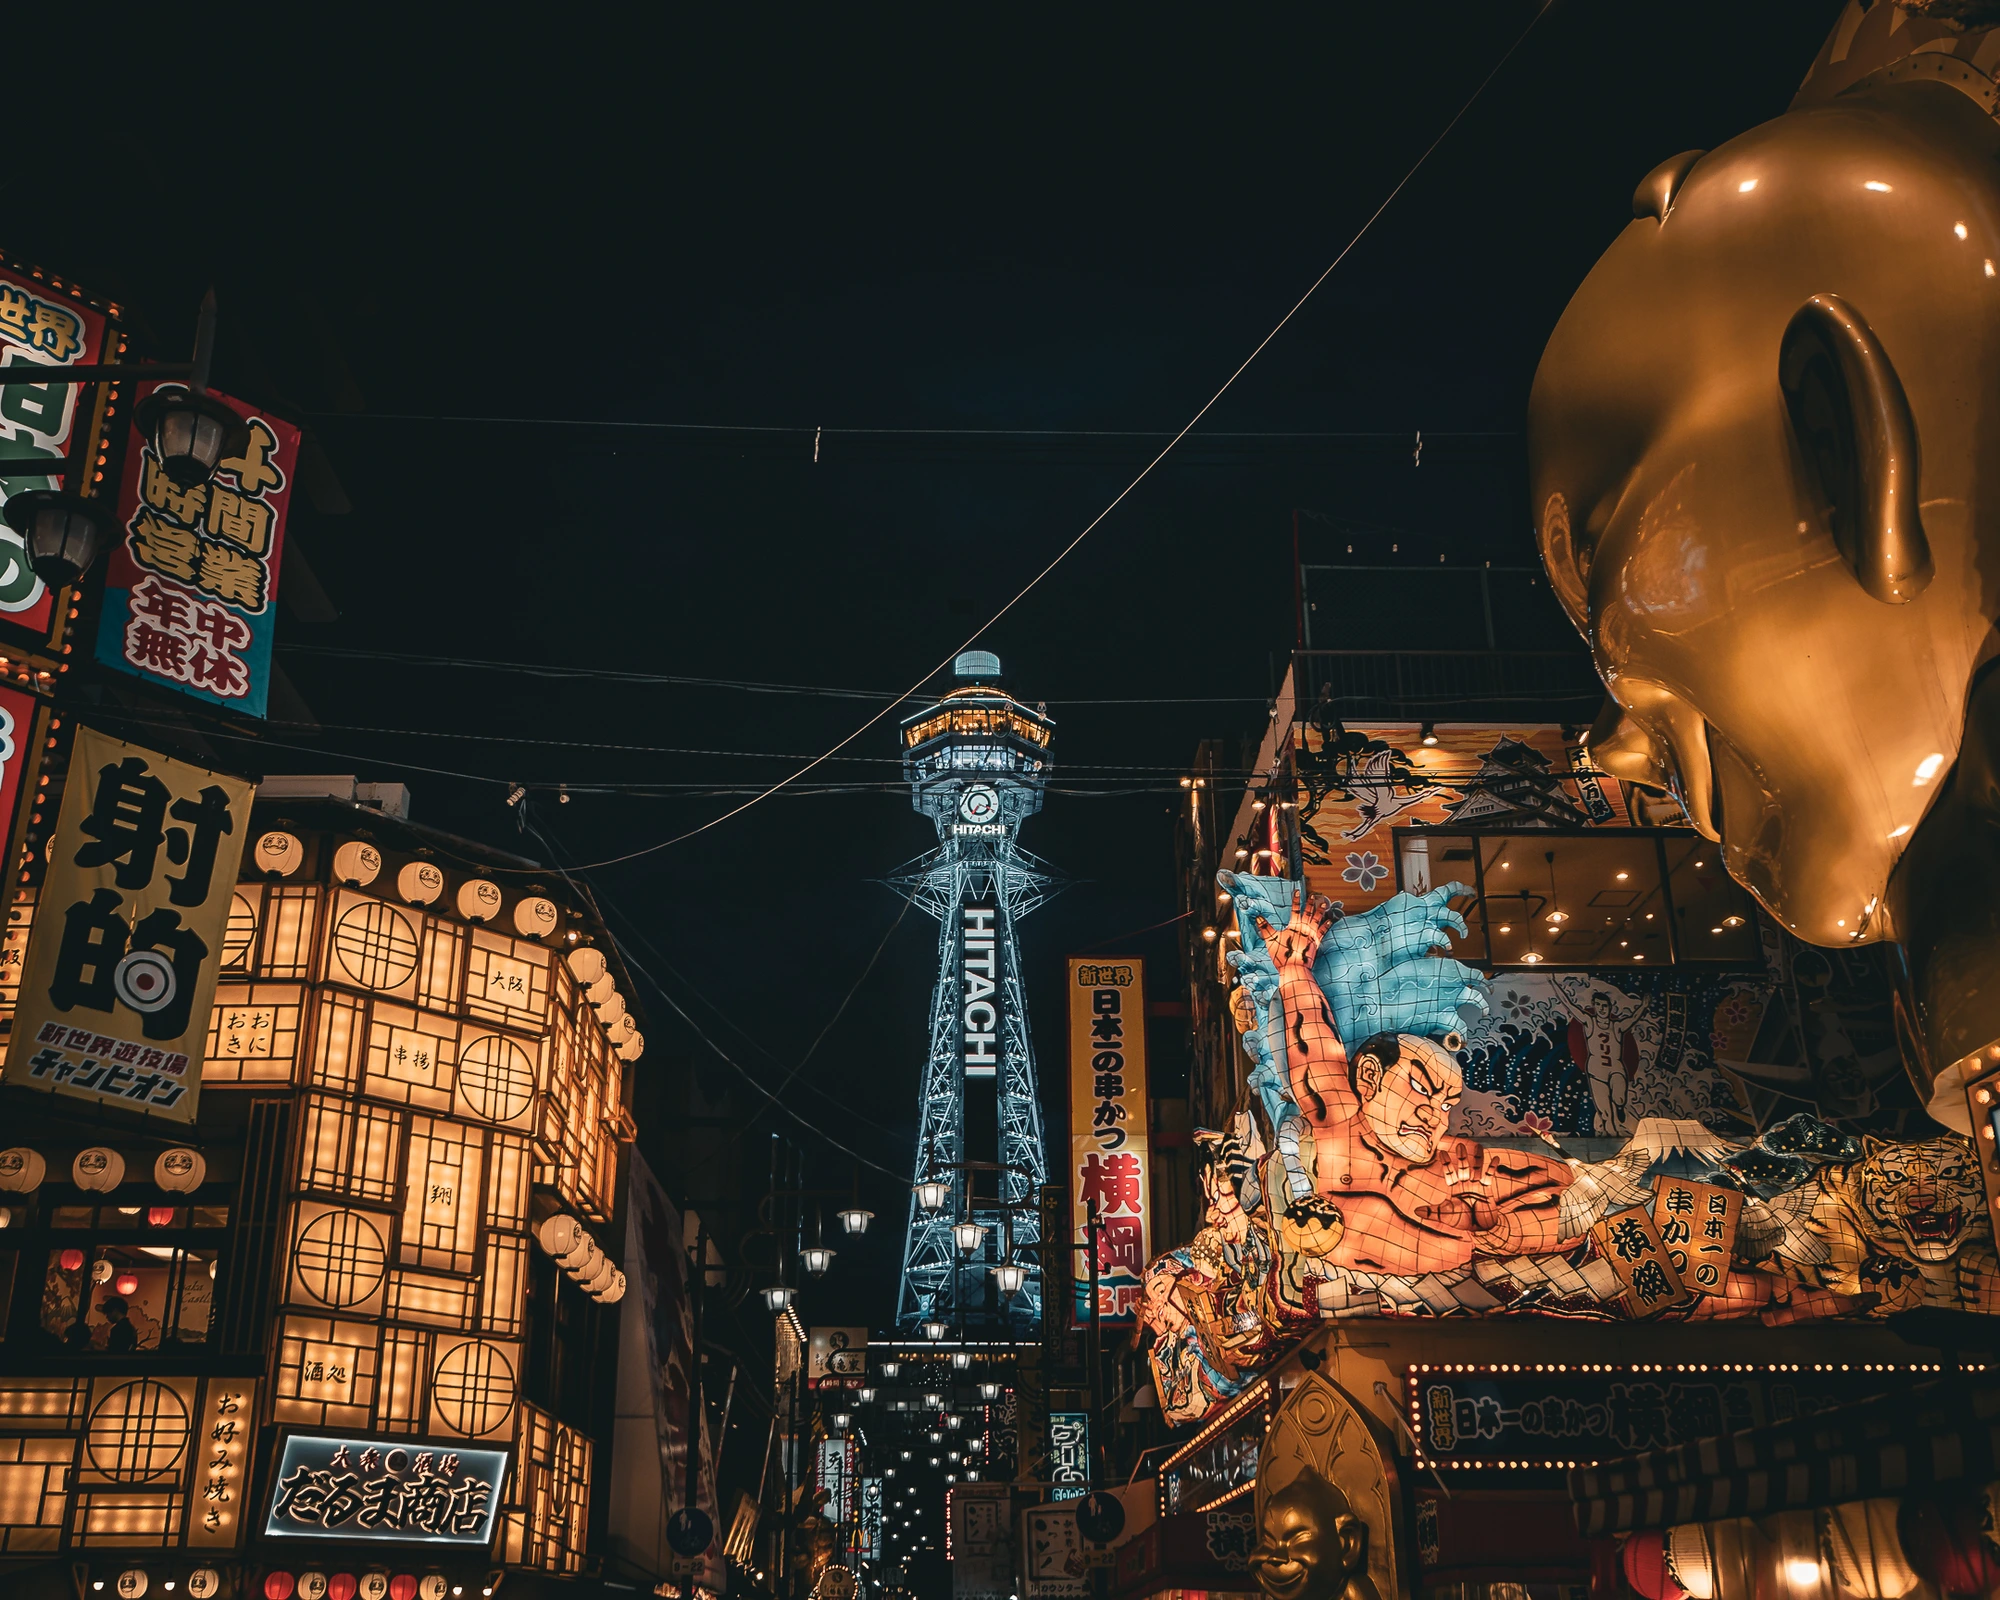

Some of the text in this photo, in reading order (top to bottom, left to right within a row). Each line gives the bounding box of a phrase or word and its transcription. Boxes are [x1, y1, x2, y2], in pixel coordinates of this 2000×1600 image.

[130, 580, 246, 652] 年中
[128, 626, 246, 693] 無休
[953, 824, 1006, 836] HITACHI
[490, 970, 526, 996] 大阪
[964, 908, 997, 1077] HITACHI
[1078, 964, 1135, 989] 新世界
[28, 1048, 188, 1108] チャンピオン
[36, 1021, 190, 1076] 新世界遊技場
[394, 1044, 430, 1071] 串揚
[1660, 1187, 1695, 1276] 串かつ
[1695, 1193, 1729, 1287] 日本一の
[304, 1360, 347, 1384] 酒処
[1428, 1385, 1455, 1450] 新世界
[203, 1392, 242, 1534] お好み焼き
[273, 1465, 494, 1536] だるま商店
